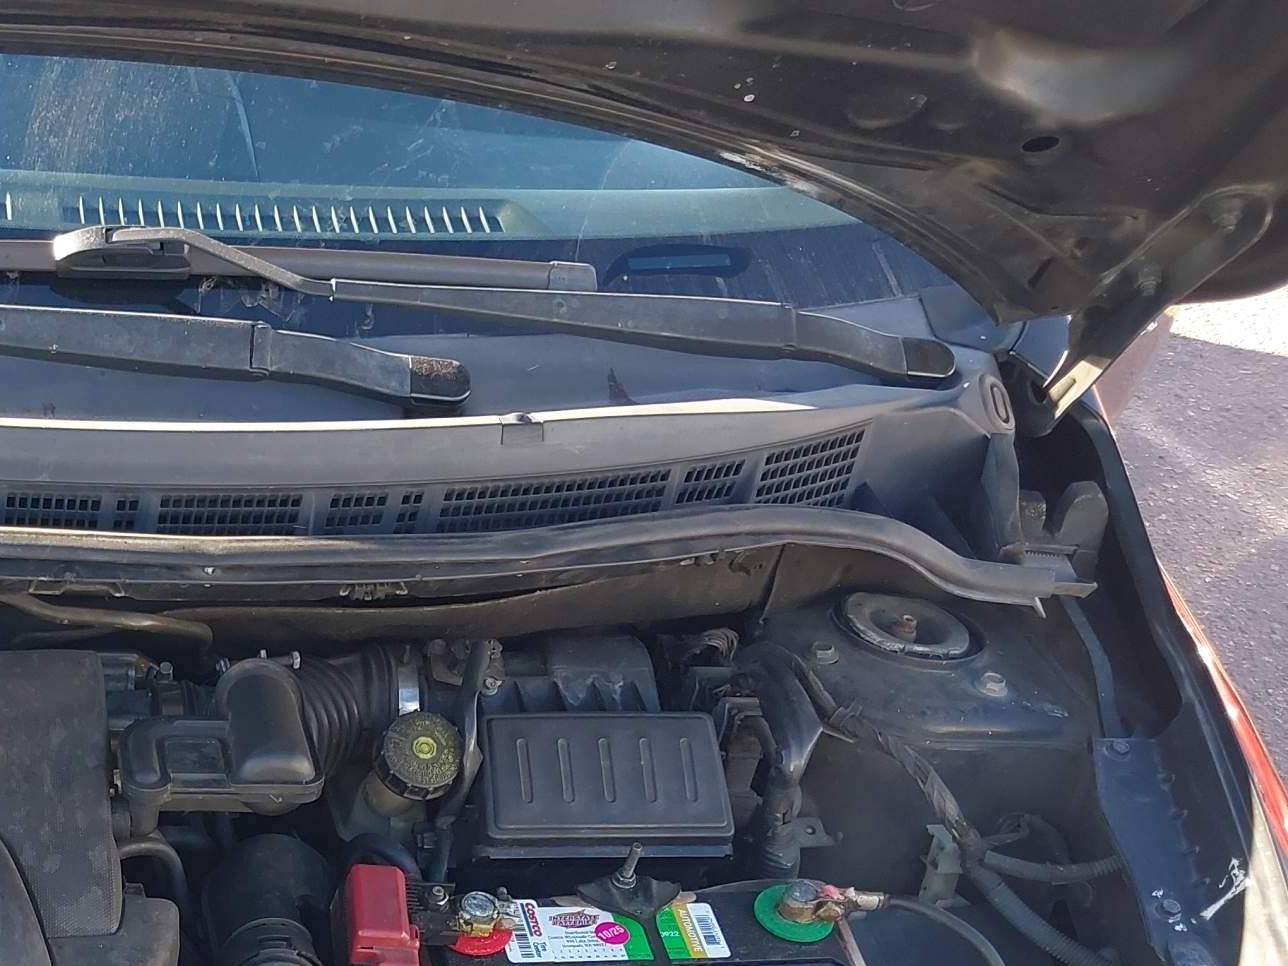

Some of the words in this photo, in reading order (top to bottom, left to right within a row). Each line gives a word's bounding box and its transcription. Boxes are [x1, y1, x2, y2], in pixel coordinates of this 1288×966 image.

[525, 903, 542, 937] COSTCO
[598, 925, 625, 940] 10/25
[678, 908, 703, 953] AUTOMOTIVE
